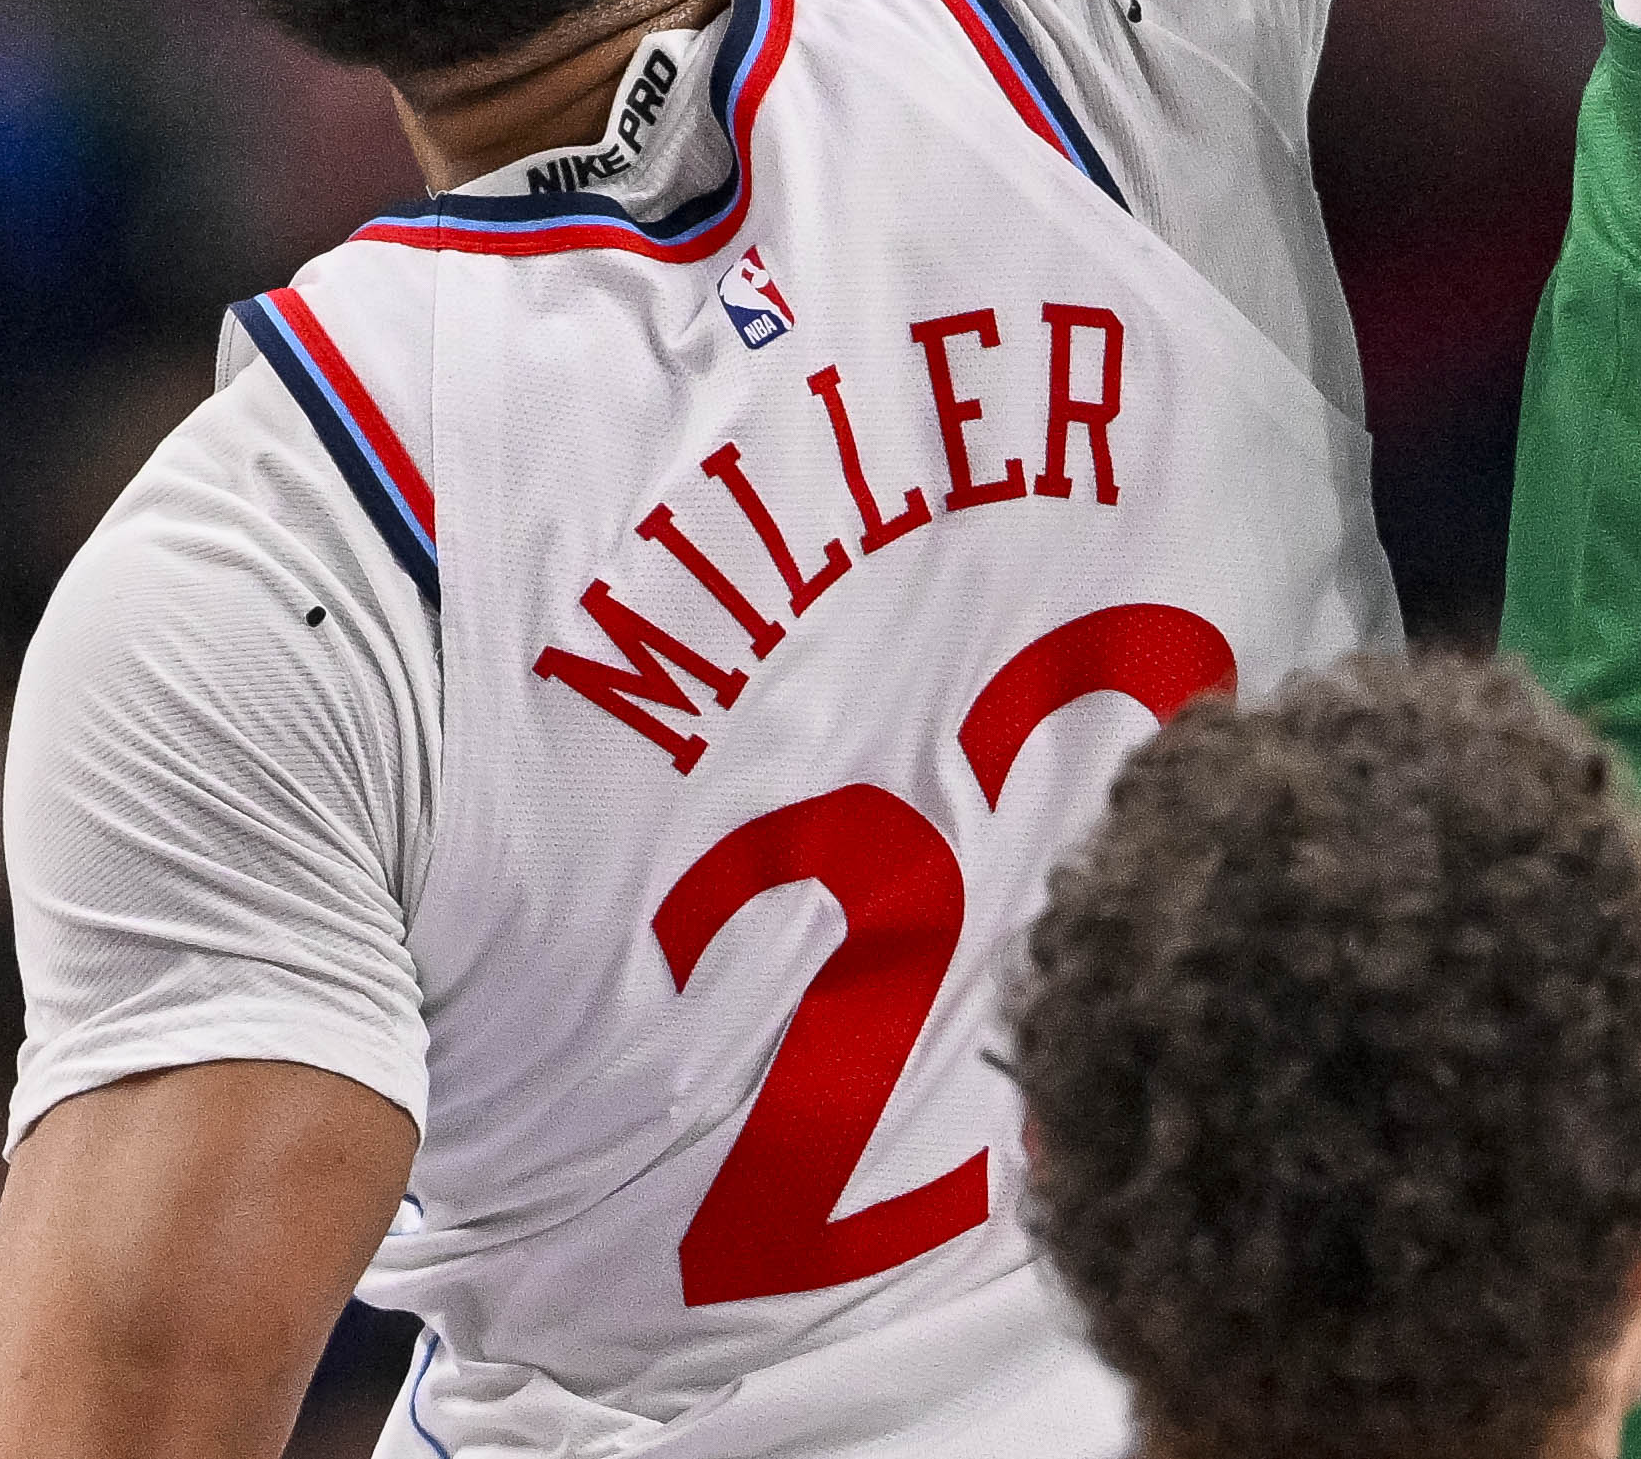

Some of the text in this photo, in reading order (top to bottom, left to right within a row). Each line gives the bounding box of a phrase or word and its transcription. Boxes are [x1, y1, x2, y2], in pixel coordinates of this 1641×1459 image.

[526, 48, 678, 194] NIKE PRO
[743, 313, 778, 345] NBA
[532, 301, 1123, 775] MILLER
